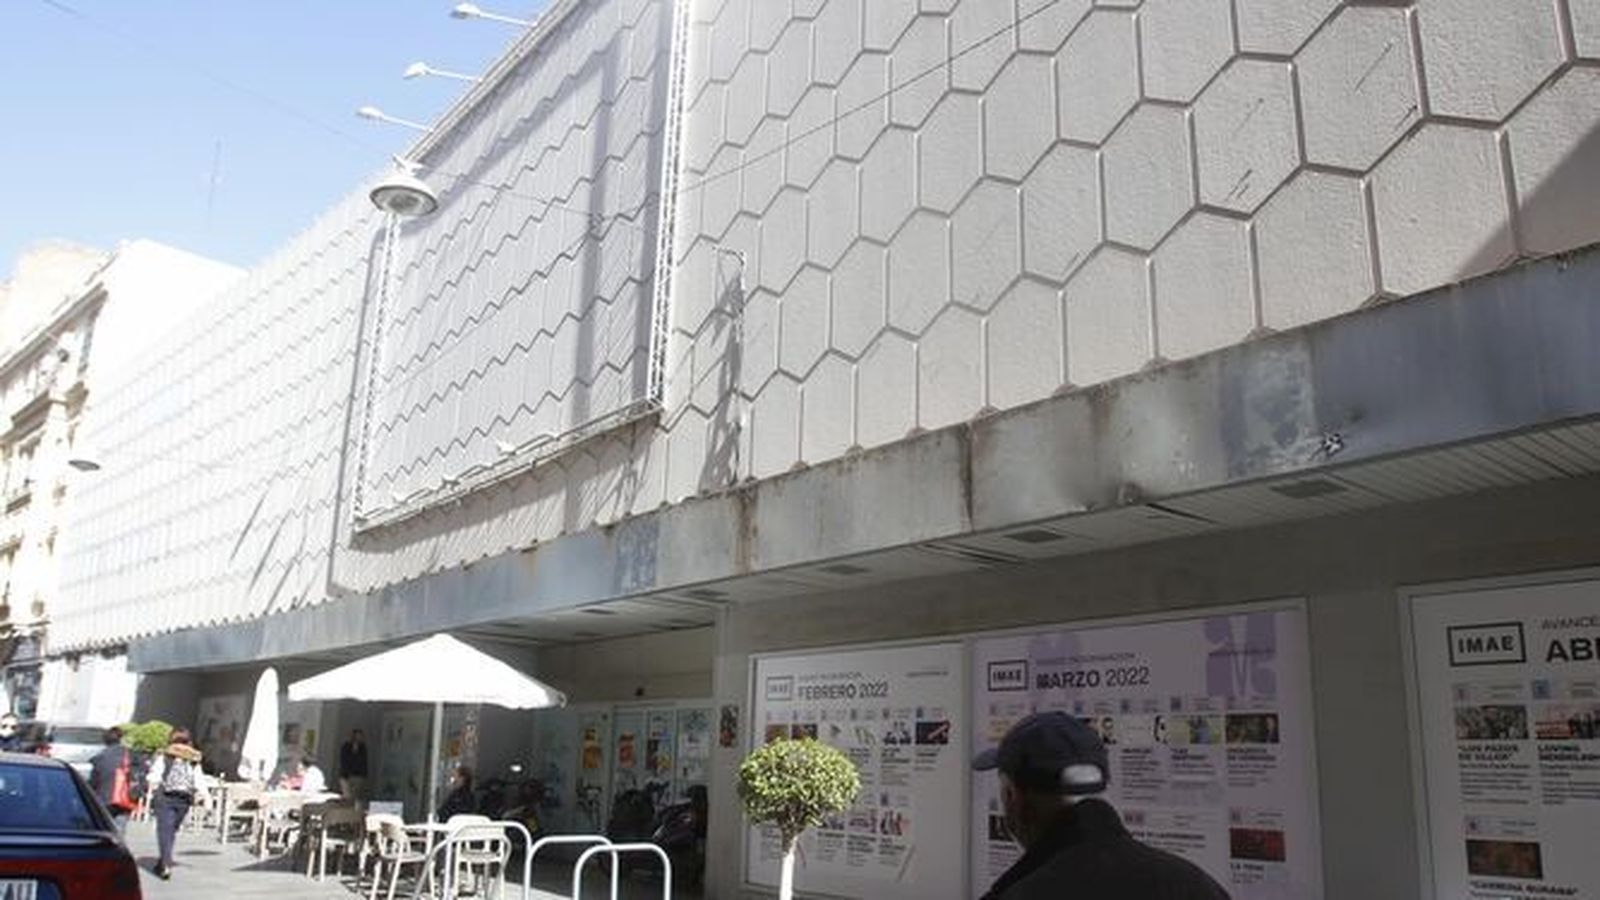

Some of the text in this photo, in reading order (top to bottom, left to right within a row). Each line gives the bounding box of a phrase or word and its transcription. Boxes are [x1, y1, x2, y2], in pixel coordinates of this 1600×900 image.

[1458, 635, 1514, 654] IMAE
[1546, 636, 1600, 663] AB
[992, 669, 1022, 682] IMAE
[1035, 666, 1150, 690] MARZO 2022
[797, 681, 889, 700] FEBRERO 2022
